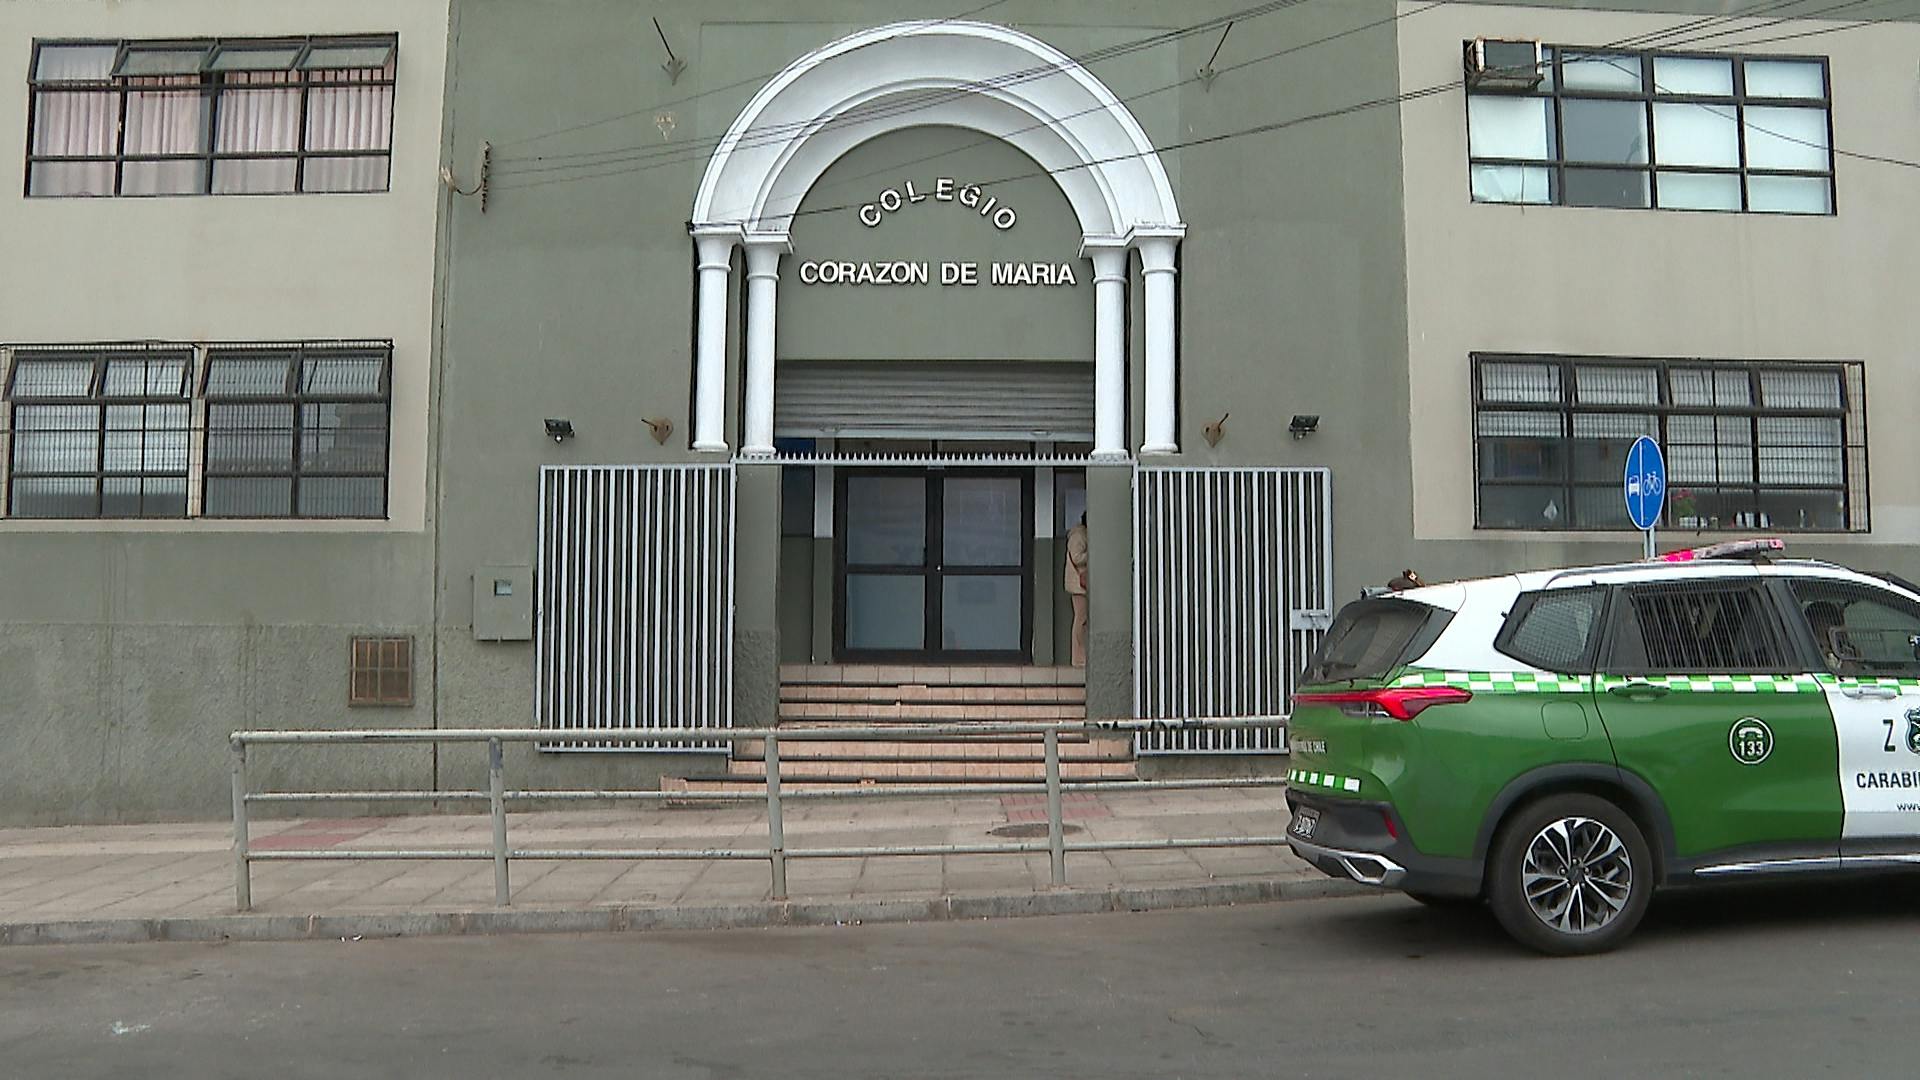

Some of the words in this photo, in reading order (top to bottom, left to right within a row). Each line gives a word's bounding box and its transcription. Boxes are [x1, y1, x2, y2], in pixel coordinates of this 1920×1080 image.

[859, 178, 1016, 230] COLEGIO
[800, 262, 928, 284] CORAZON
[941, 263, 978, 284] DE
[991, 263, 1076, 285] MARIA
[1882, 718, 1896, 752] Z
[1739, 741, 1764, 756] 133
[1856, 771, 1920, 788] CARABI
